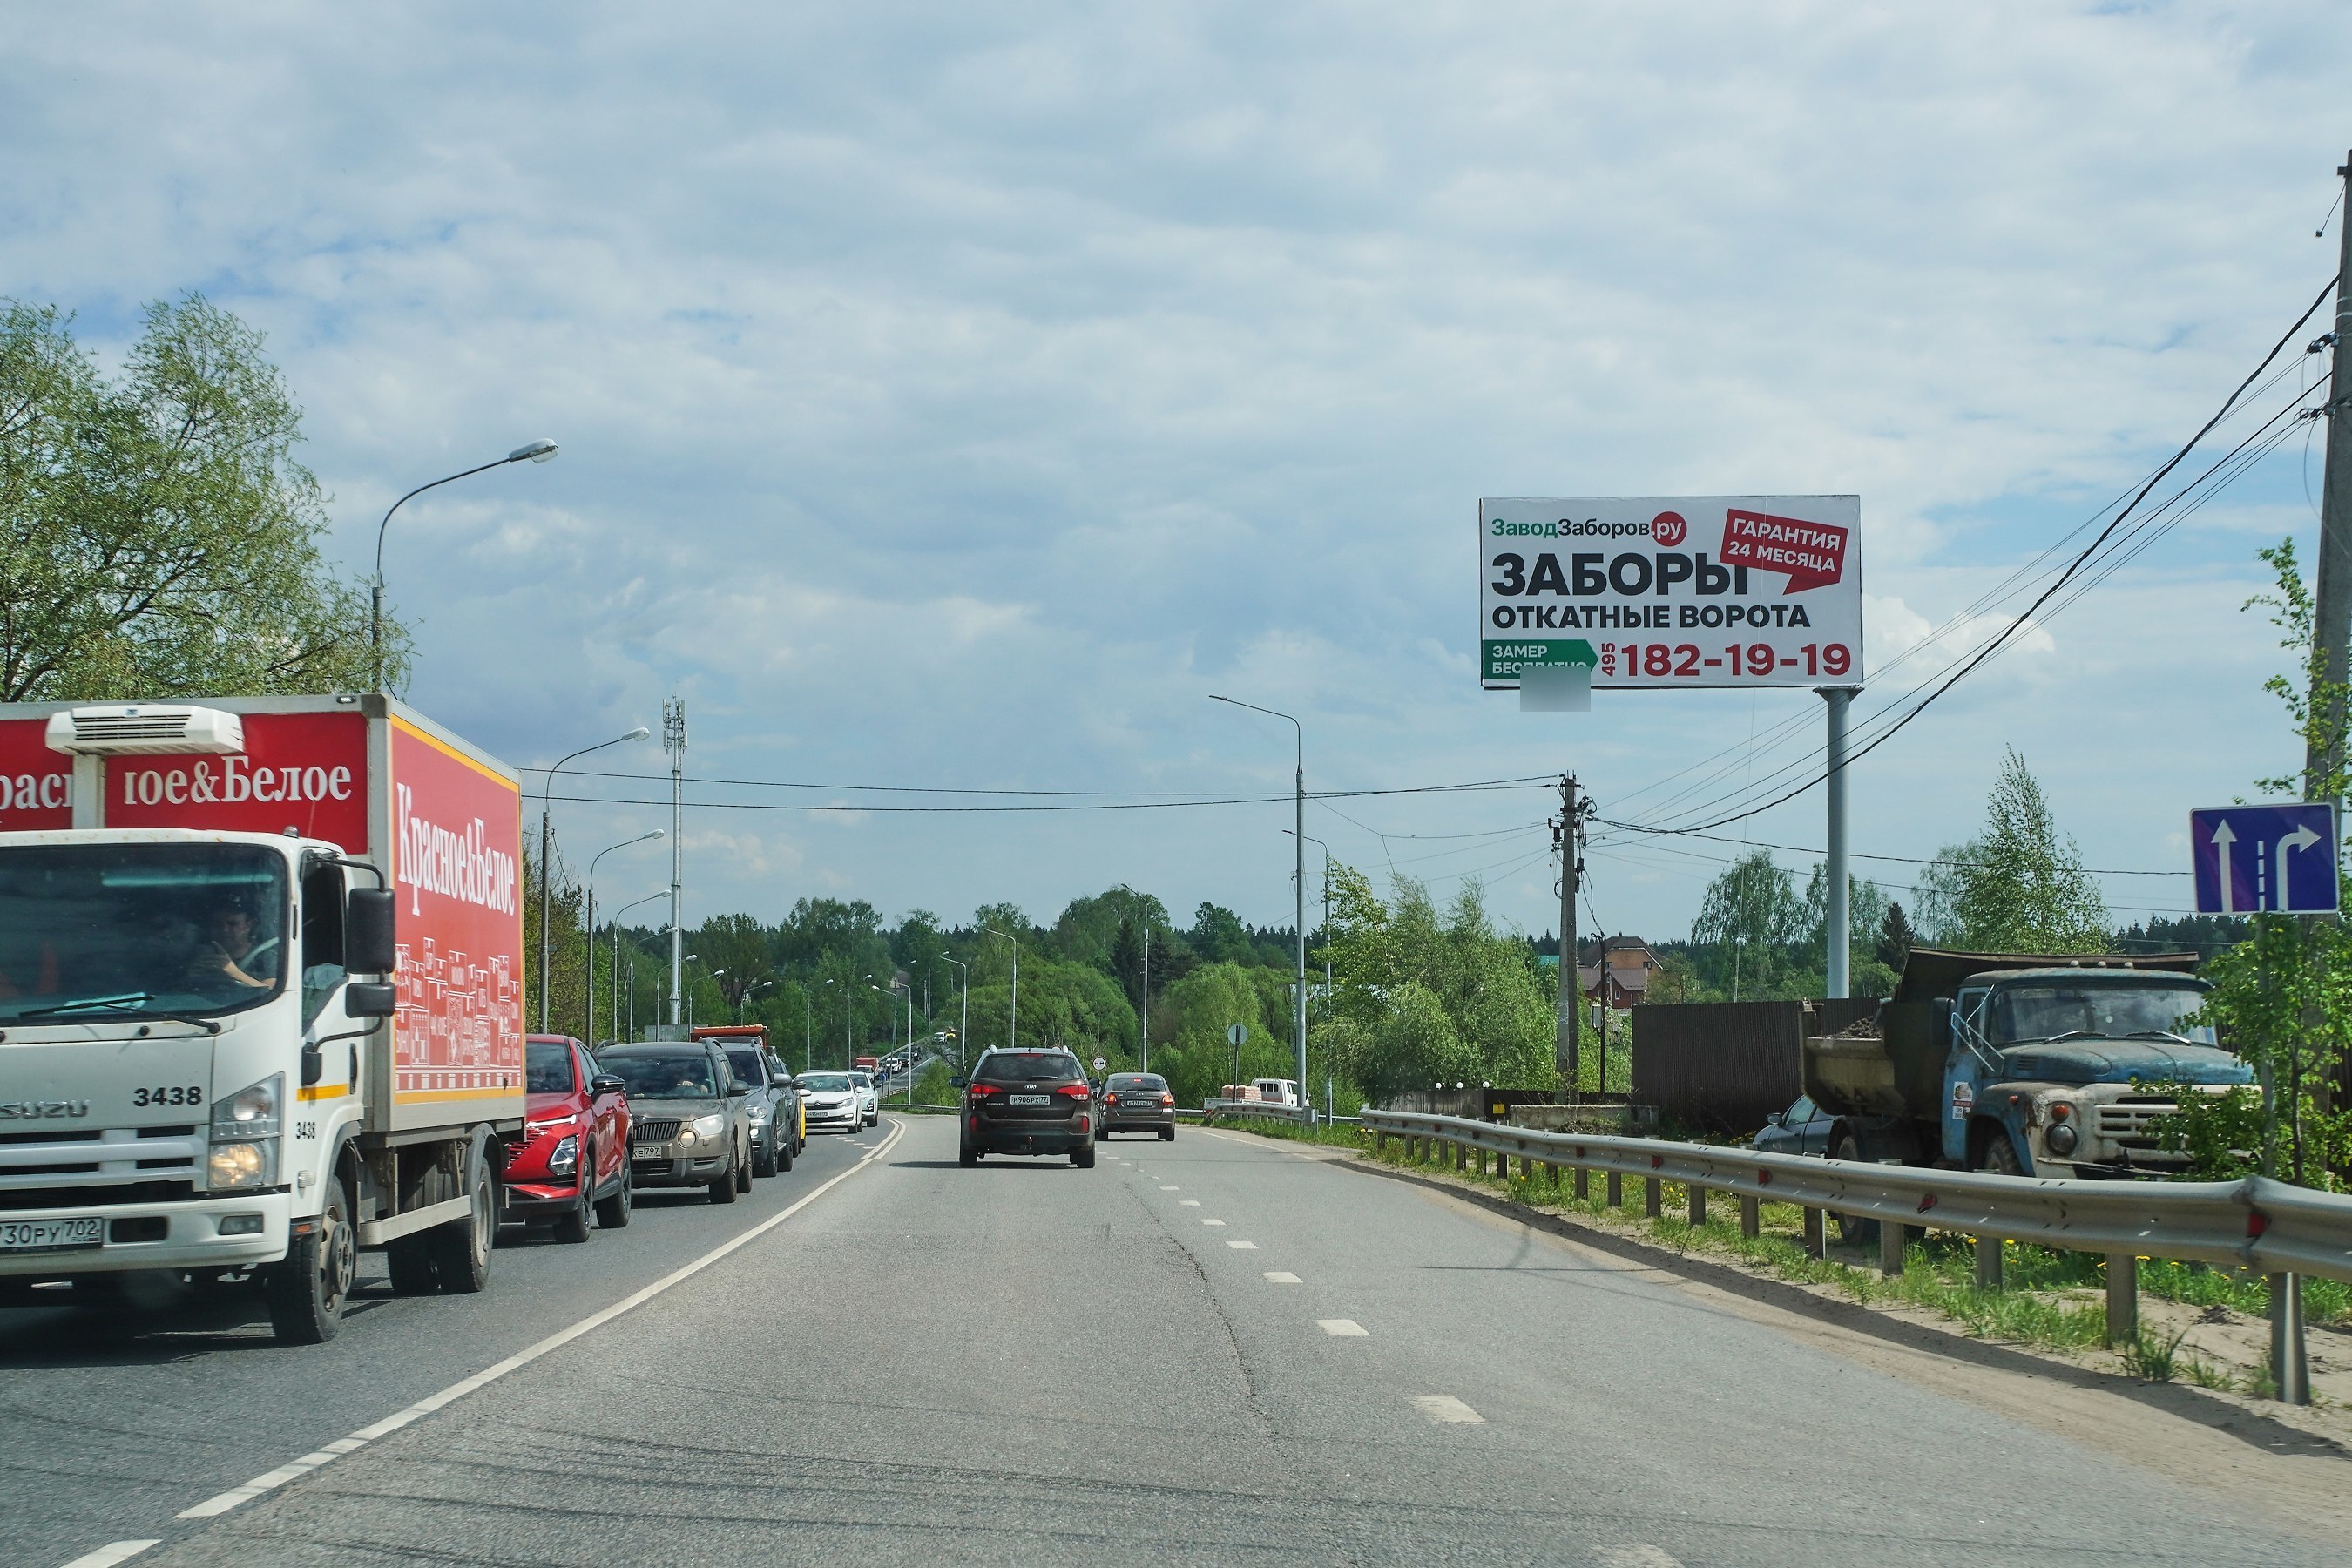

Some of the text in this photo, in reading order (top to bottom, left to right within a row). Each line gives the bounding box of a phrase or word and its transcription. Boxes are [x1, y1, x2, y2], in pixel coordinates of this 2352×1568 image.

[1733, 517, 1841, 551] ГАРАНТИЯ
[1727, 541, 1836, 572] 24 МЕСЯЦА
[1491, 552, 1747, 596] ЗАБОРЫ
[1492, 605, 1812, 629] ОТКАТНЫЕ ВОРОТА
[1492, 645, 1548, 658] ЗАМЕР
[1601, 642, 1616, 677] 495
[1621, 643, 1852, 677] 182-19-19
[397, 781, 515, 916] Красное&Белое
[133, 1085, 203, 1107] 3438
[295, 1121, 316, 1140] 3438
[64, 1220, 98, 1237] 702
